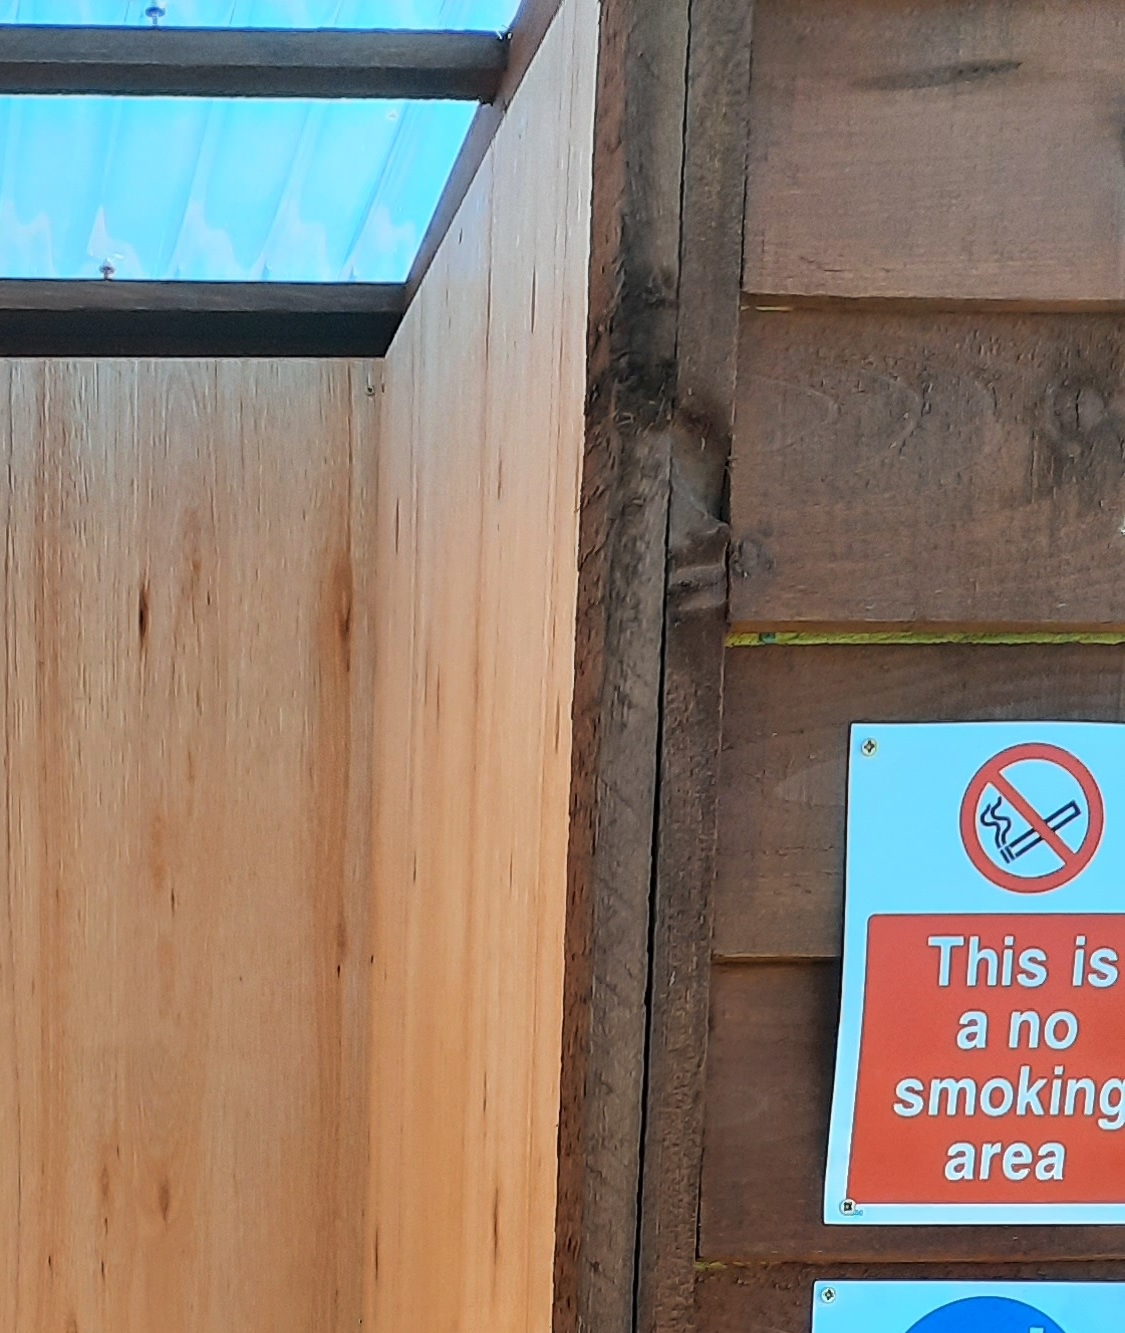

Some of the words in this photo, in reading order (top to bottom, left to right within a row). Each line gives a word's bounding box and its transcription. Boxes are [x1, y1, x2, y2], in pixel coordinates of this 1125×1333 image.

[927, 935, 1048, 988] This
[1072, 935, 1119, 988] is
[956, 1010, 988, 1050] a
[1007, 1010, 1078, 1050] no
[893, 1065, 1125, 1130] smoking
[944, 1142, 1065, 1181] area
